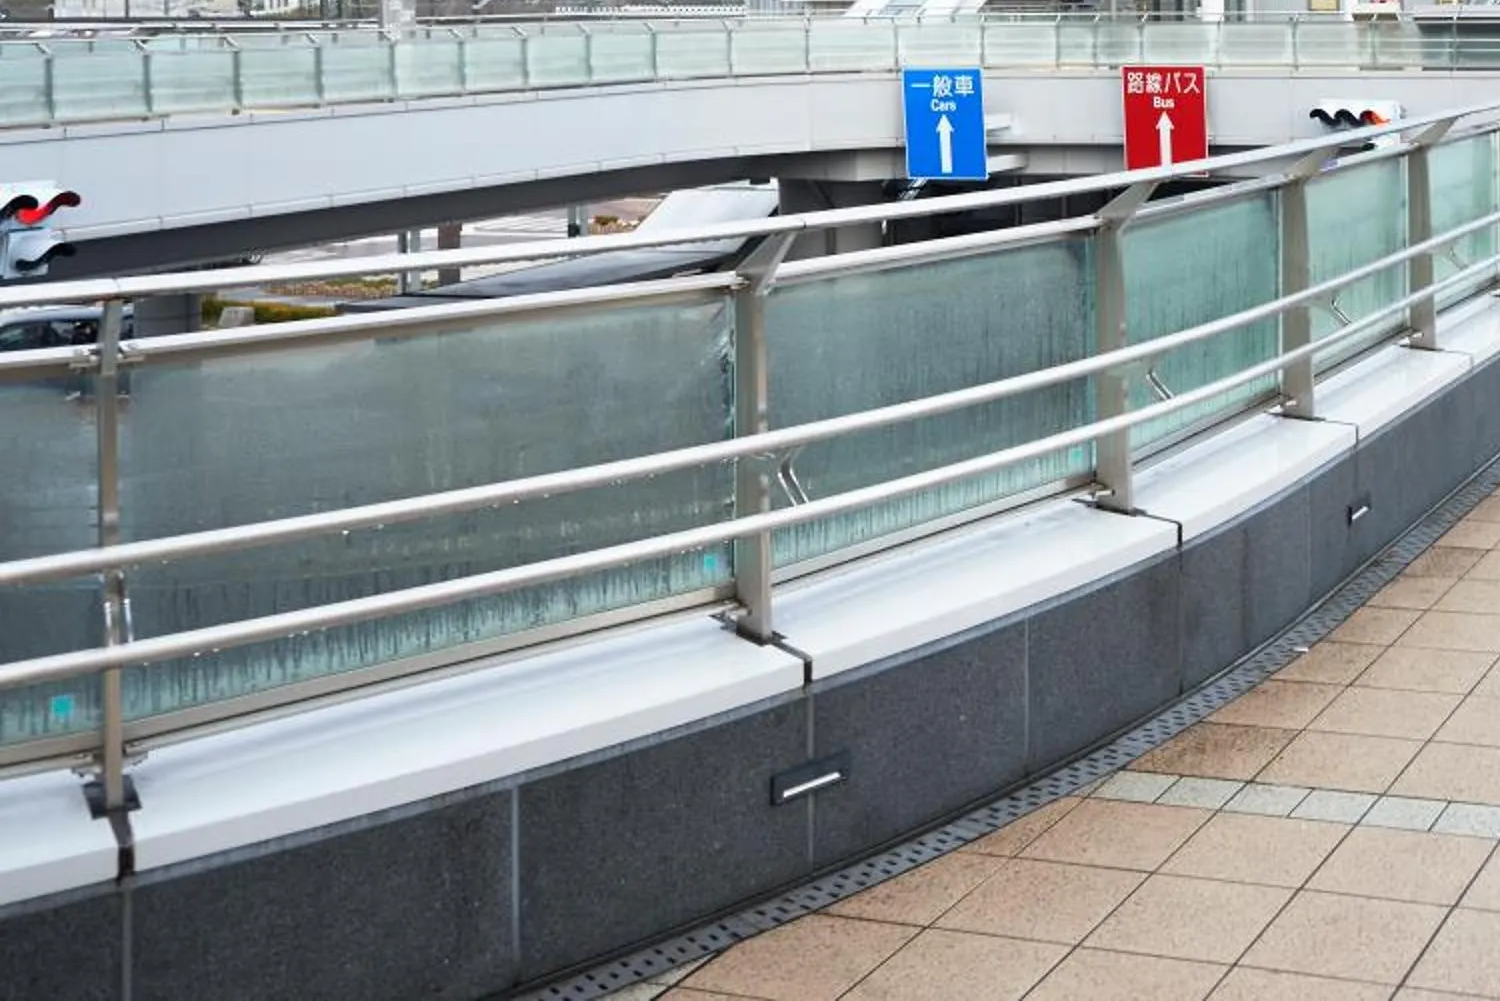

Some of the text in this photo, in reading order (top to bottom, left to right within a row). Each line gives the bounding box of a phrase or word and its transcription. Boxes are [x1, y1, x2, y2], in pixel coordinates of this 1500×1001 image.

[911, 74, 975, 98] 一般車
[1127, 71, 1201, 94] 路線バス
[930, 98, 957, 112] Cars
[1153, 96, 1175, 109] Bus
